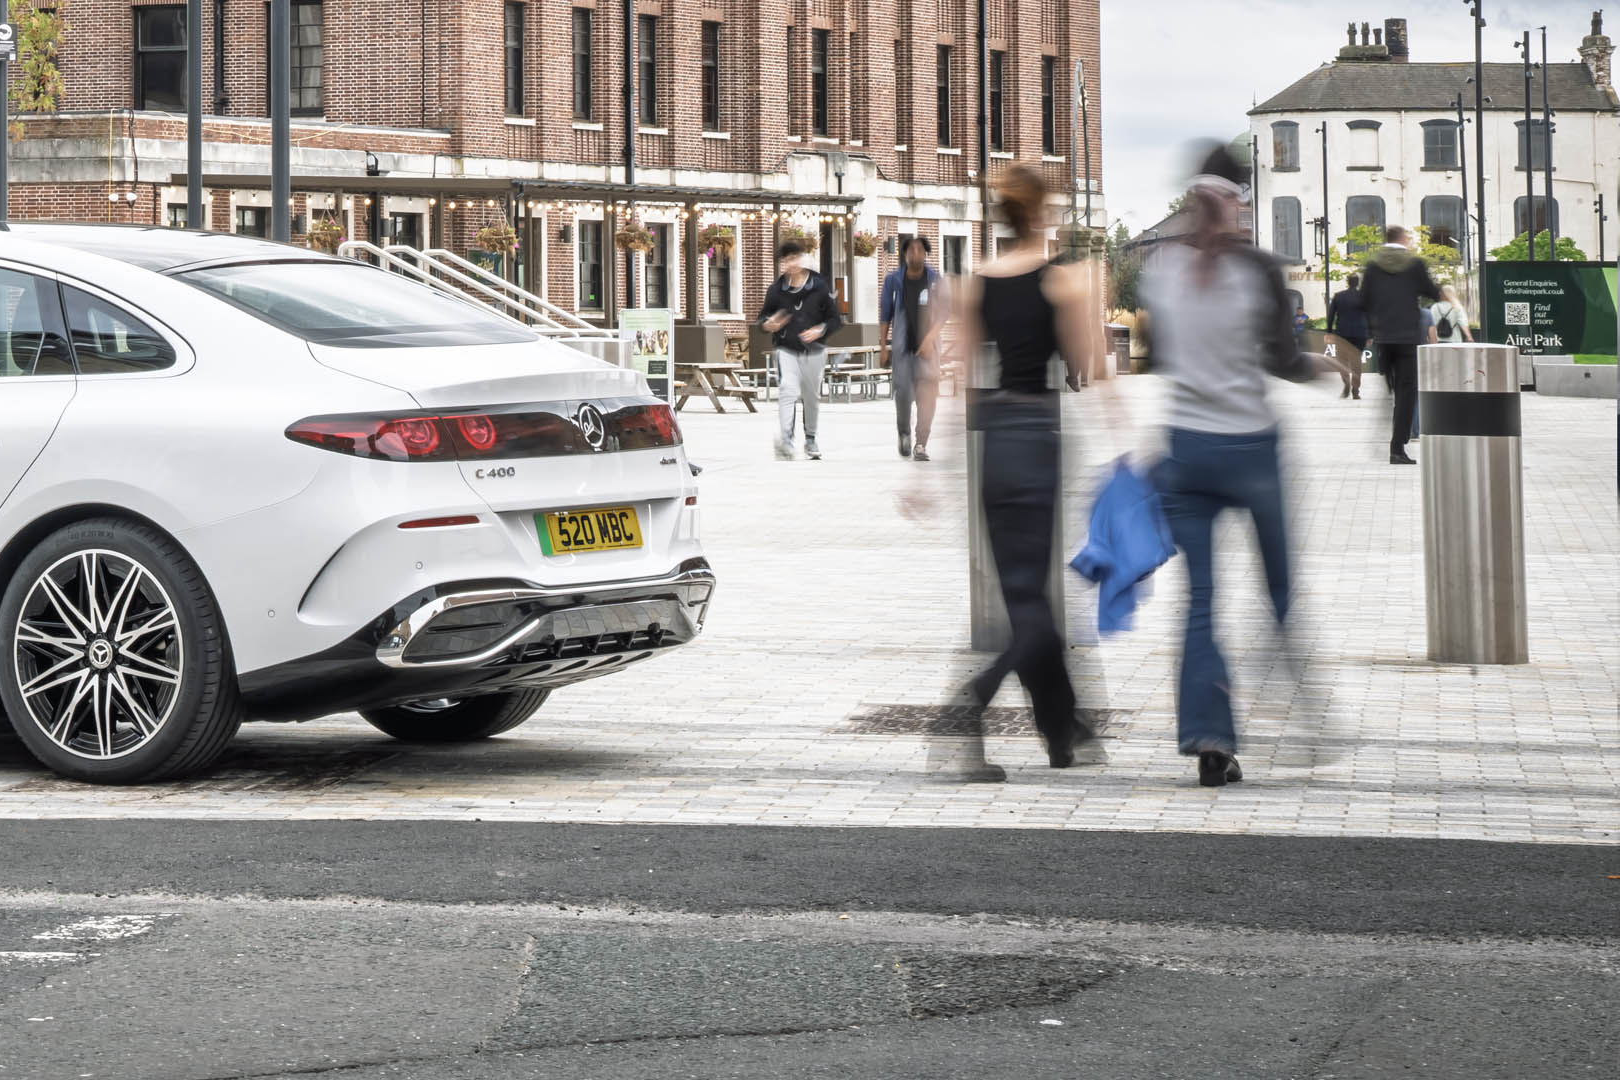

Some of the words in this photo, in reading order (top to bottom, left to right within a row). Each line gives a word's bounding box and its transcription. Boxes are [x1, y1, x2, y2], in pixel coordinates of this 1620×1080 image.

[1529, 280, 1558, 288] Enquiries
[1505, 334, 1532, 346] Aire
[1534, 334, 1563, 347] Park
[475, 469, 485, 479] C
[487, 466, 516, 477] 400
[558, 515, 595, 547] 520
[595, 512, 634, 544] MBC
